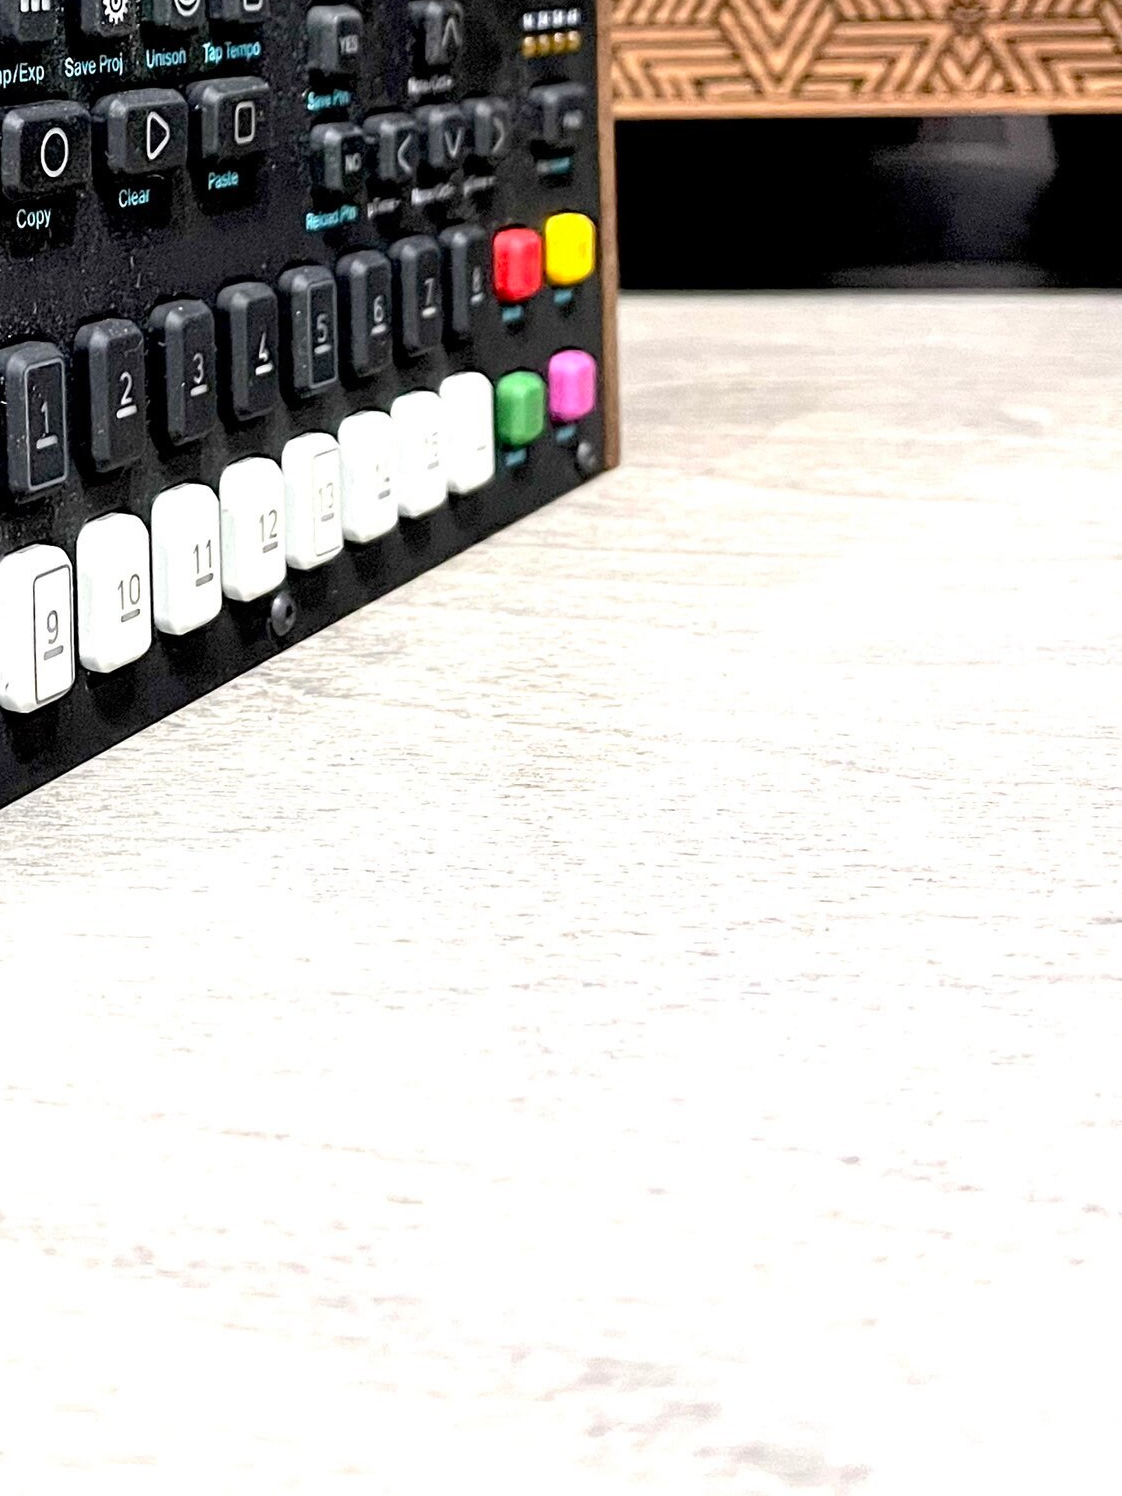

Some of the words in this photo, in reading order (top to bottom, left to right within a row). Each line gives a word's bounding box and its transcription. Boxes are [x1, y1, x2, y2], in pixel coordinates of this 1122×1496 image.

[64, 56, 97, 78] Save
[99, 53, 124, 76] Proj
[146, 49, 187, 69] Unison
[203, 43, 222, 64] Tap
[226, 40, 262, 61] Tempo
[208, 171, 240, 191] Paste
[118, 188, 151, 208] Clear
[16, 208, 52, 229] Copy
[373, 295, 385, 324] 6
[316, 313, 328, 344] 5
[192, 353, 204, 384] 3
[119, 372, 133, 405] 2
[40, 401, 50, 434] 1
[258, 509, 278, 543] 12
[193, 539, 213, 574] 11
[117, 573, 141, 611] 10
[46, 609, 59, 645] 9
